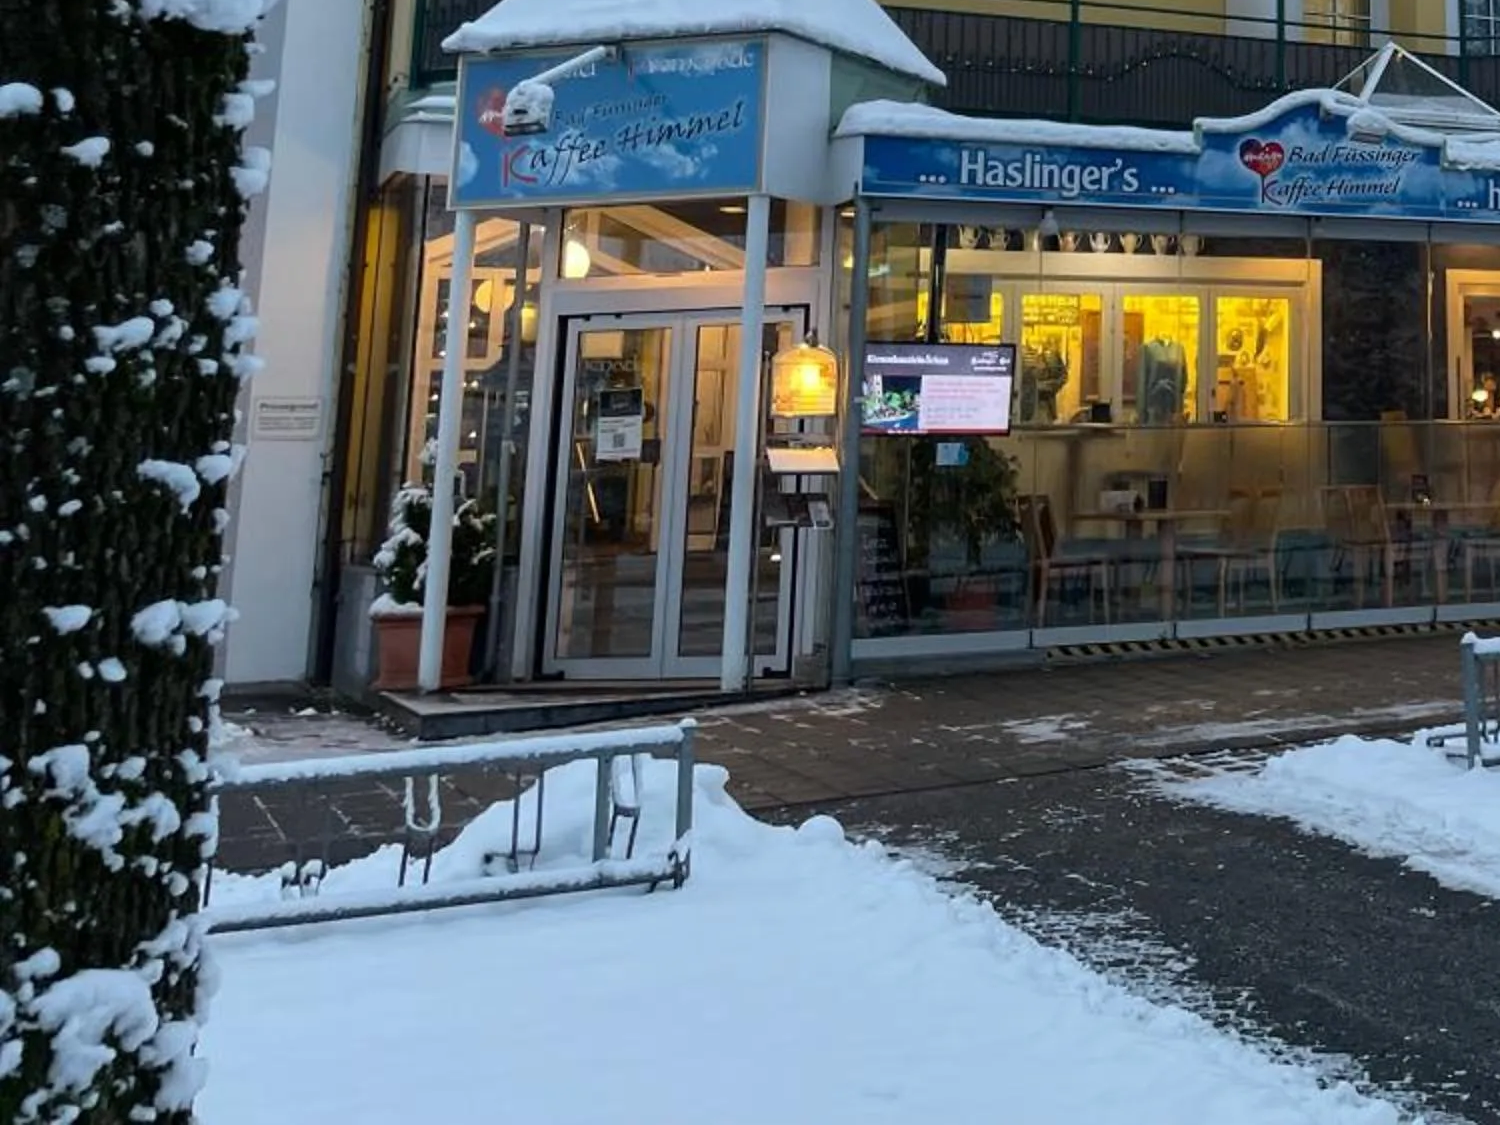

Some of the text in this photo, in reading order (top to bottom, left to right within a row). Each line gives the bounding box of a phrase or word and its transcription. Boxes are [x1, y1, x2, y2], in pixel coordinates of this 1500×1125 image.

[501, 100, 746, 187] Kaffee Himmel
[1288, 144, 1330, 163] Bad
[960, 150, 1140, 197] Haslinger's
[1261, 175, 1400, 206] Kaffee Himmel
